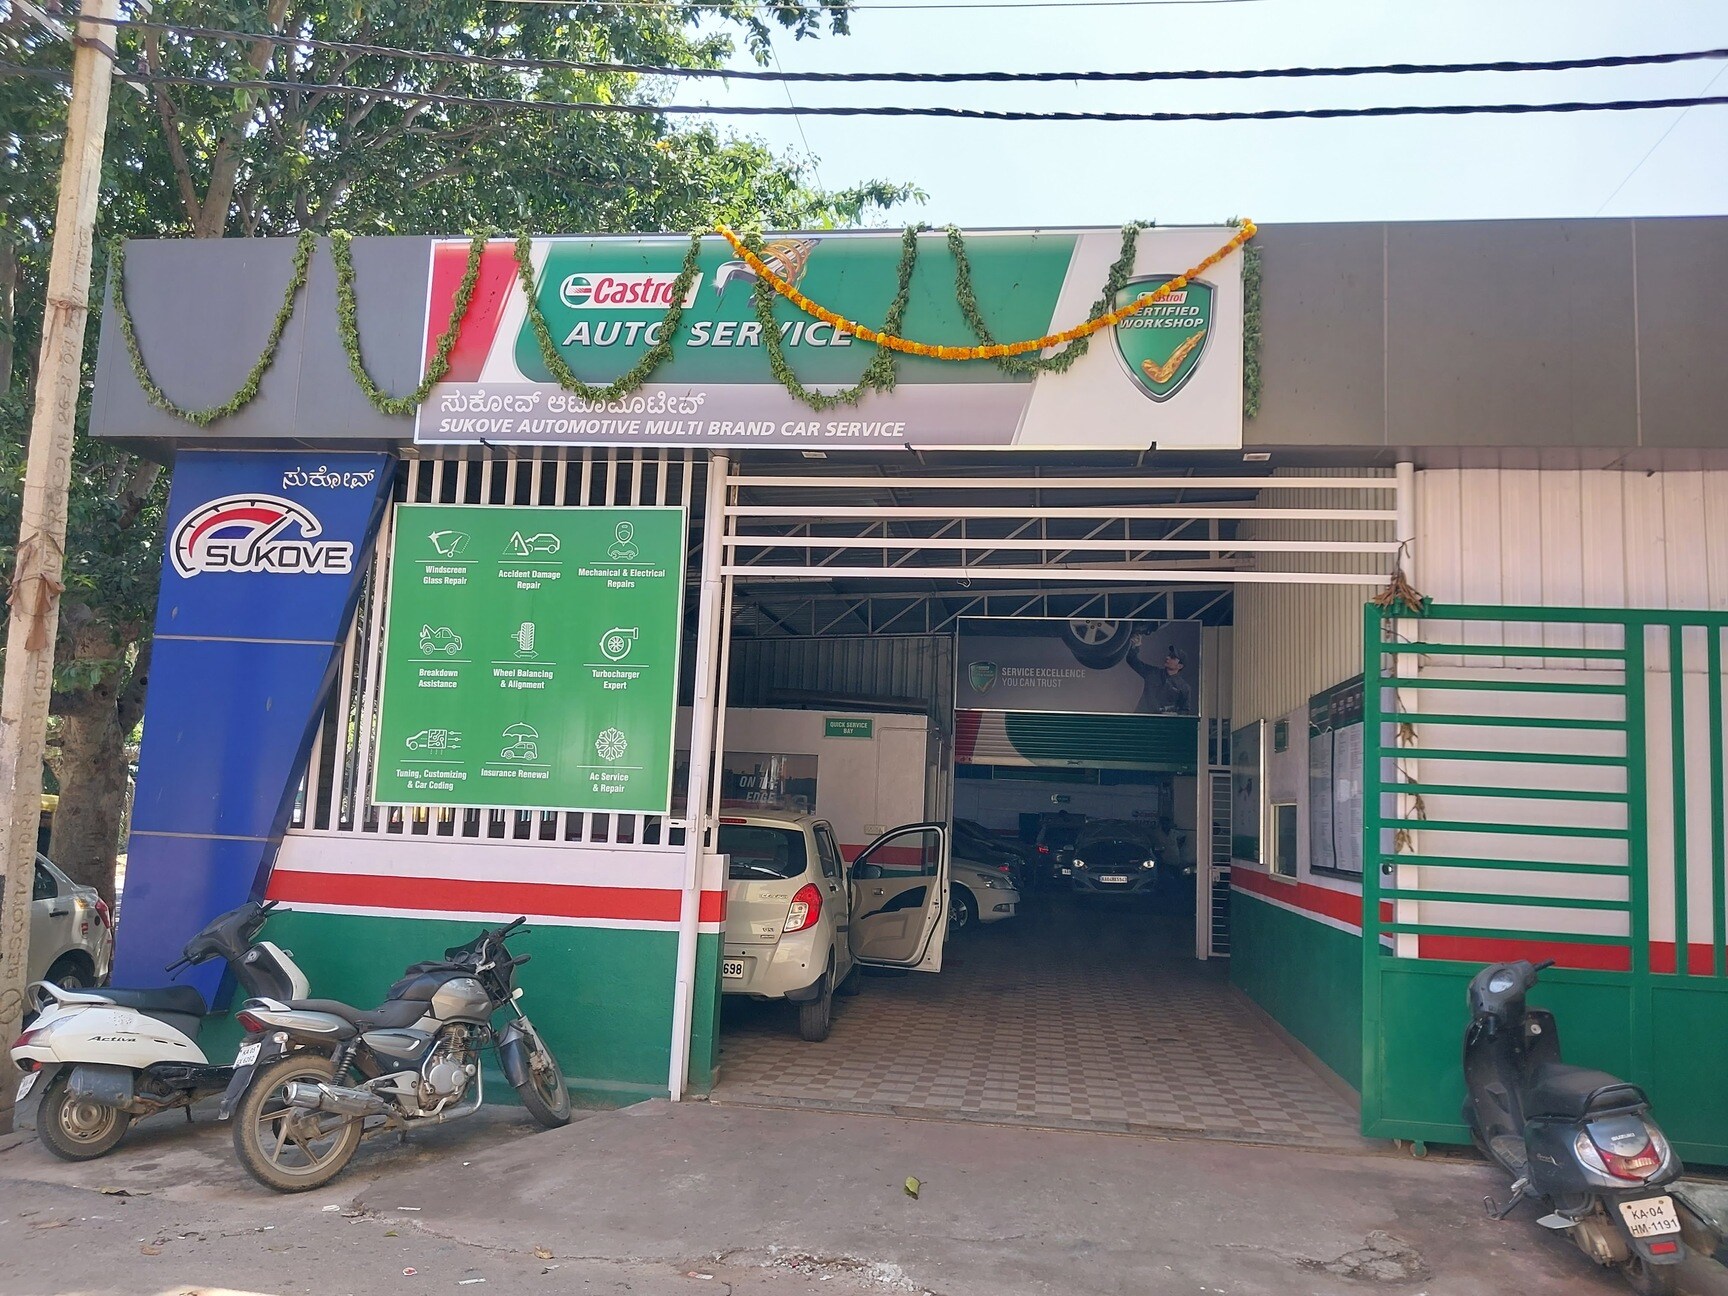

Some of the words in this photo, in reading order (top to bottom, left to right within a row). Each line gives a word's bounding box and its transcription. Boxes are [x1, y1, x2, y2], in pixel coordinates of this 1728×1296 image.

[593, 277, 688, 304] Castro
[1127, 306, 1200, 317] ERTIFIED
[1120, 318, 1204, 329] WORKSHOP
[439, 418, 514, 433] SUKOVE
[516, 419, 642, 435] AUTOMOTIVE
[644, 420, 704, 436] MULTI
[707, 421, 776, 436] BRAND
[780, 421, 821, 437] CAR
[824, 422, 906, 437] SERVICE
[205, 544, 348, 568] SUKOVE
[425, 565, 467, 574] Windscreen
[498, 570, 531, 578] Accident
[532, 570, 561, 580] Damage
[578, 568, 621, 577] Mechanical
[622, 569, 628, 577] &
[630, 569, 666, 577] Electrical
[423, 577, 443, 585] Glass
[444, 577, 468, 586] Repair
[516, 581, 541, 591] Repair
[607, 580, 635, 589] Repairs
[419, 668, 458, 677] Breakdown
[493, 668, 516, 677] Wheel
[517, 669, 554, 680] Balancing
[592, 669, 640, 680] Turbocharger
[1001, 667, 1035, 677] SERVICE
[1035, 668, 1086, 678] EXCELLENCE
[418, 679, 458, 688] Assistance
[500, 680, 507, 688] &
[508, 680, 545, 690] Alignment
[603, 681, 627, 691] Expert
[1001, 677, 1018, 687] YOU
[1019, 678, 1036, 687] CAN
[1036, 678, 1062, 688] TRUST
[396, 769, 422, 779] Tuning,
[423, 770, 467, 781] Customizing
[480, 768, 517, 777] Insurance
[518, 770, 550, 779] Renewal
[589, 772, 600, 781] Ac
[601, 772, 629, 781] Service
[407, 780, 414, 789] &
[415, 780, 428, 789] Car
[429, 781, 454, 791] Coding
[592, 783, 599, 792] &
[600, 783, 625, 794] Repair
